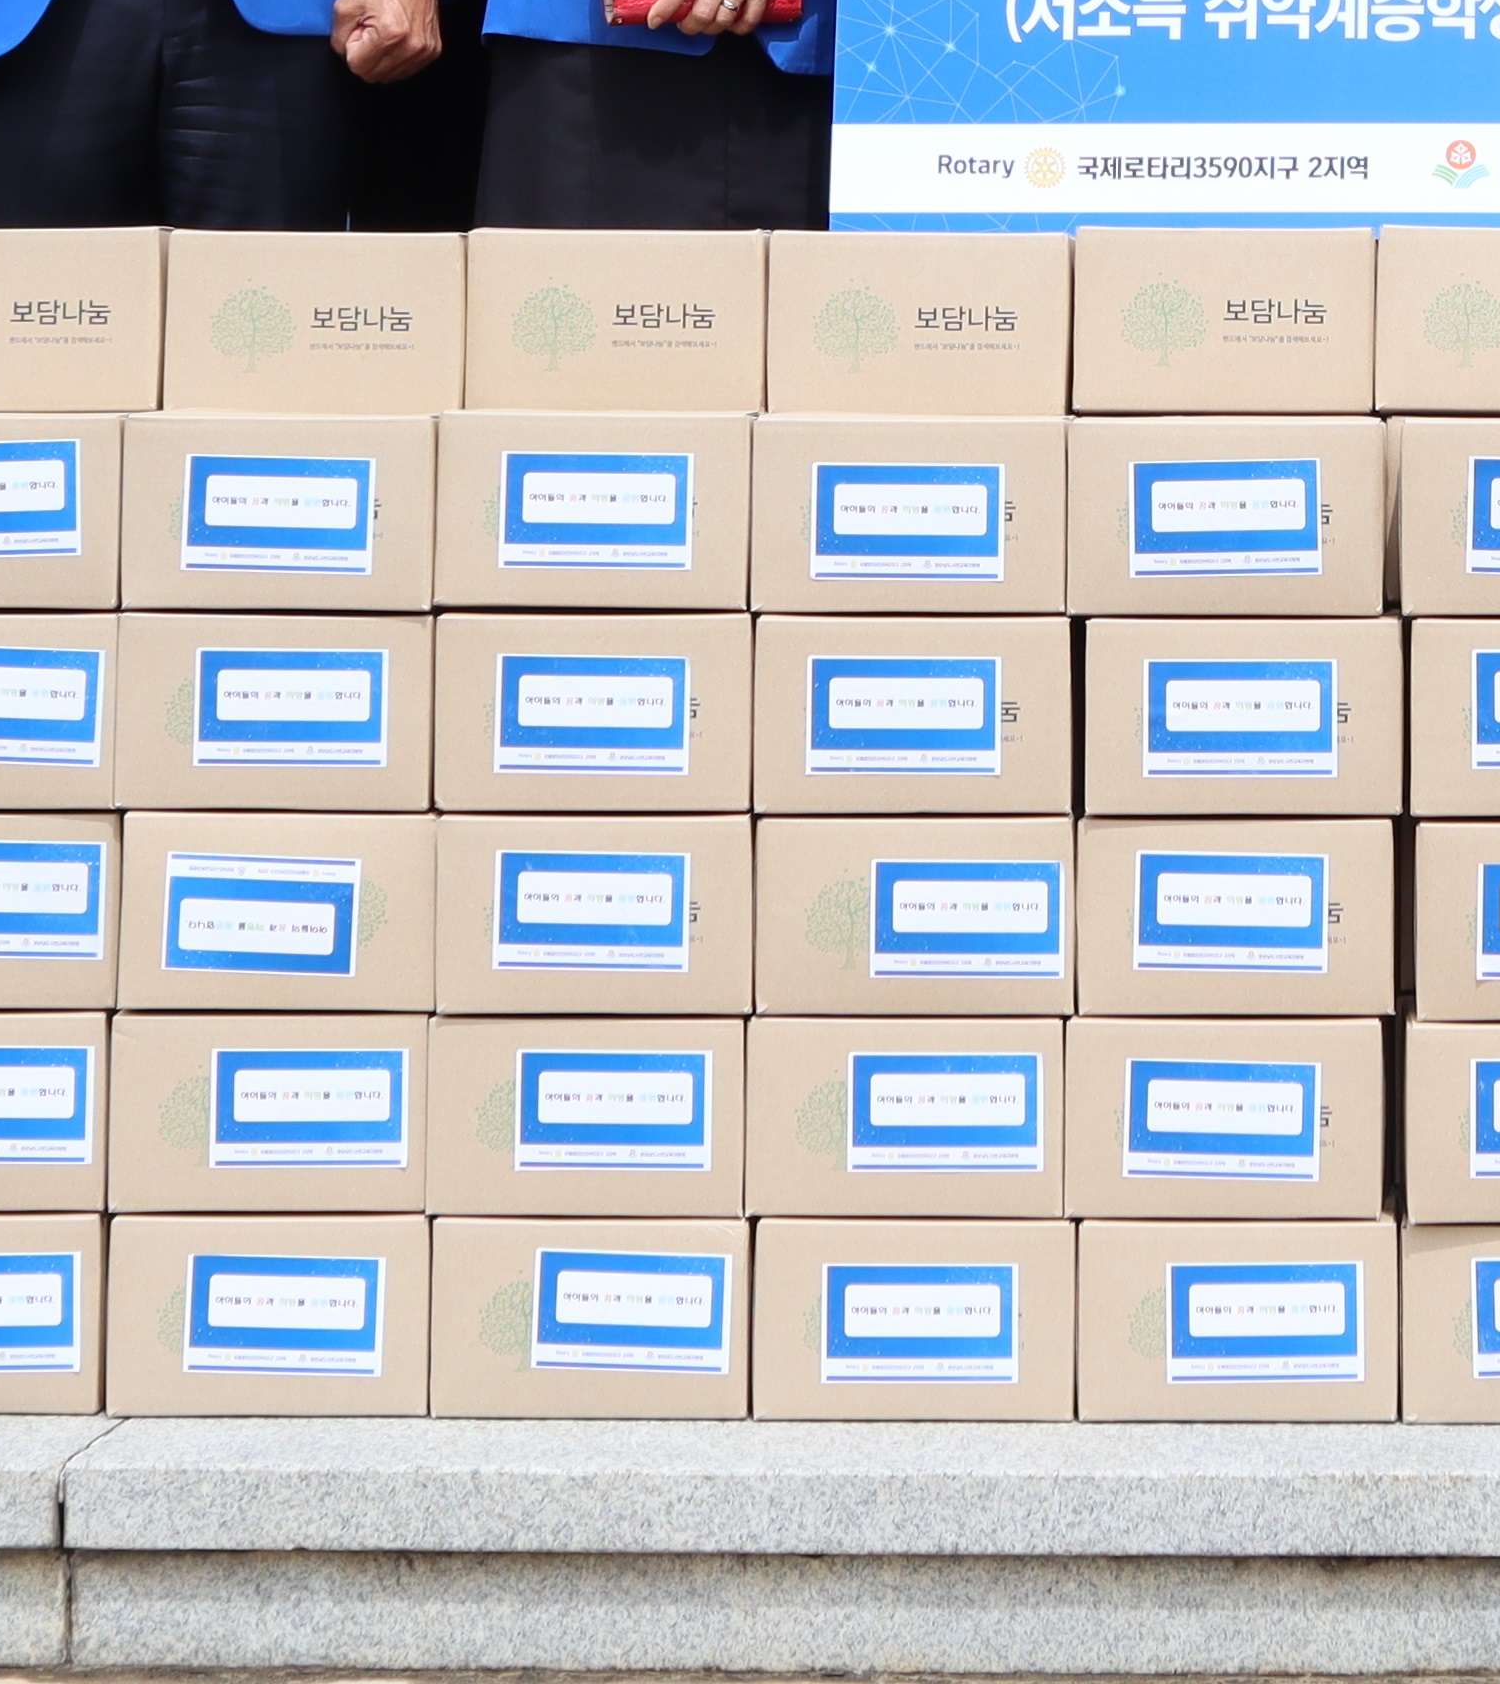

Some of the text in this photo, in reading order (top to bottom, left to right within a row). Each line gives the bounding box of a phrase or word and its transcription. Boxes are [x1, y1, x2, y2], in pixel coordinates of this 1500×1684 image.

[936, 153, 1016, 180] Rotary
[1076, 154, 1370, 182] 국제로타리3590지구 2지역
[10, 300, 111, 325] 보담나눔
[312, 305, 412, 332] 보담나눔
[612, 302, 715, 329] 보담나눔
[914, 305, 1018, 332] 보담나눔
[1222, 297, 1328, 325] 보담나눔
